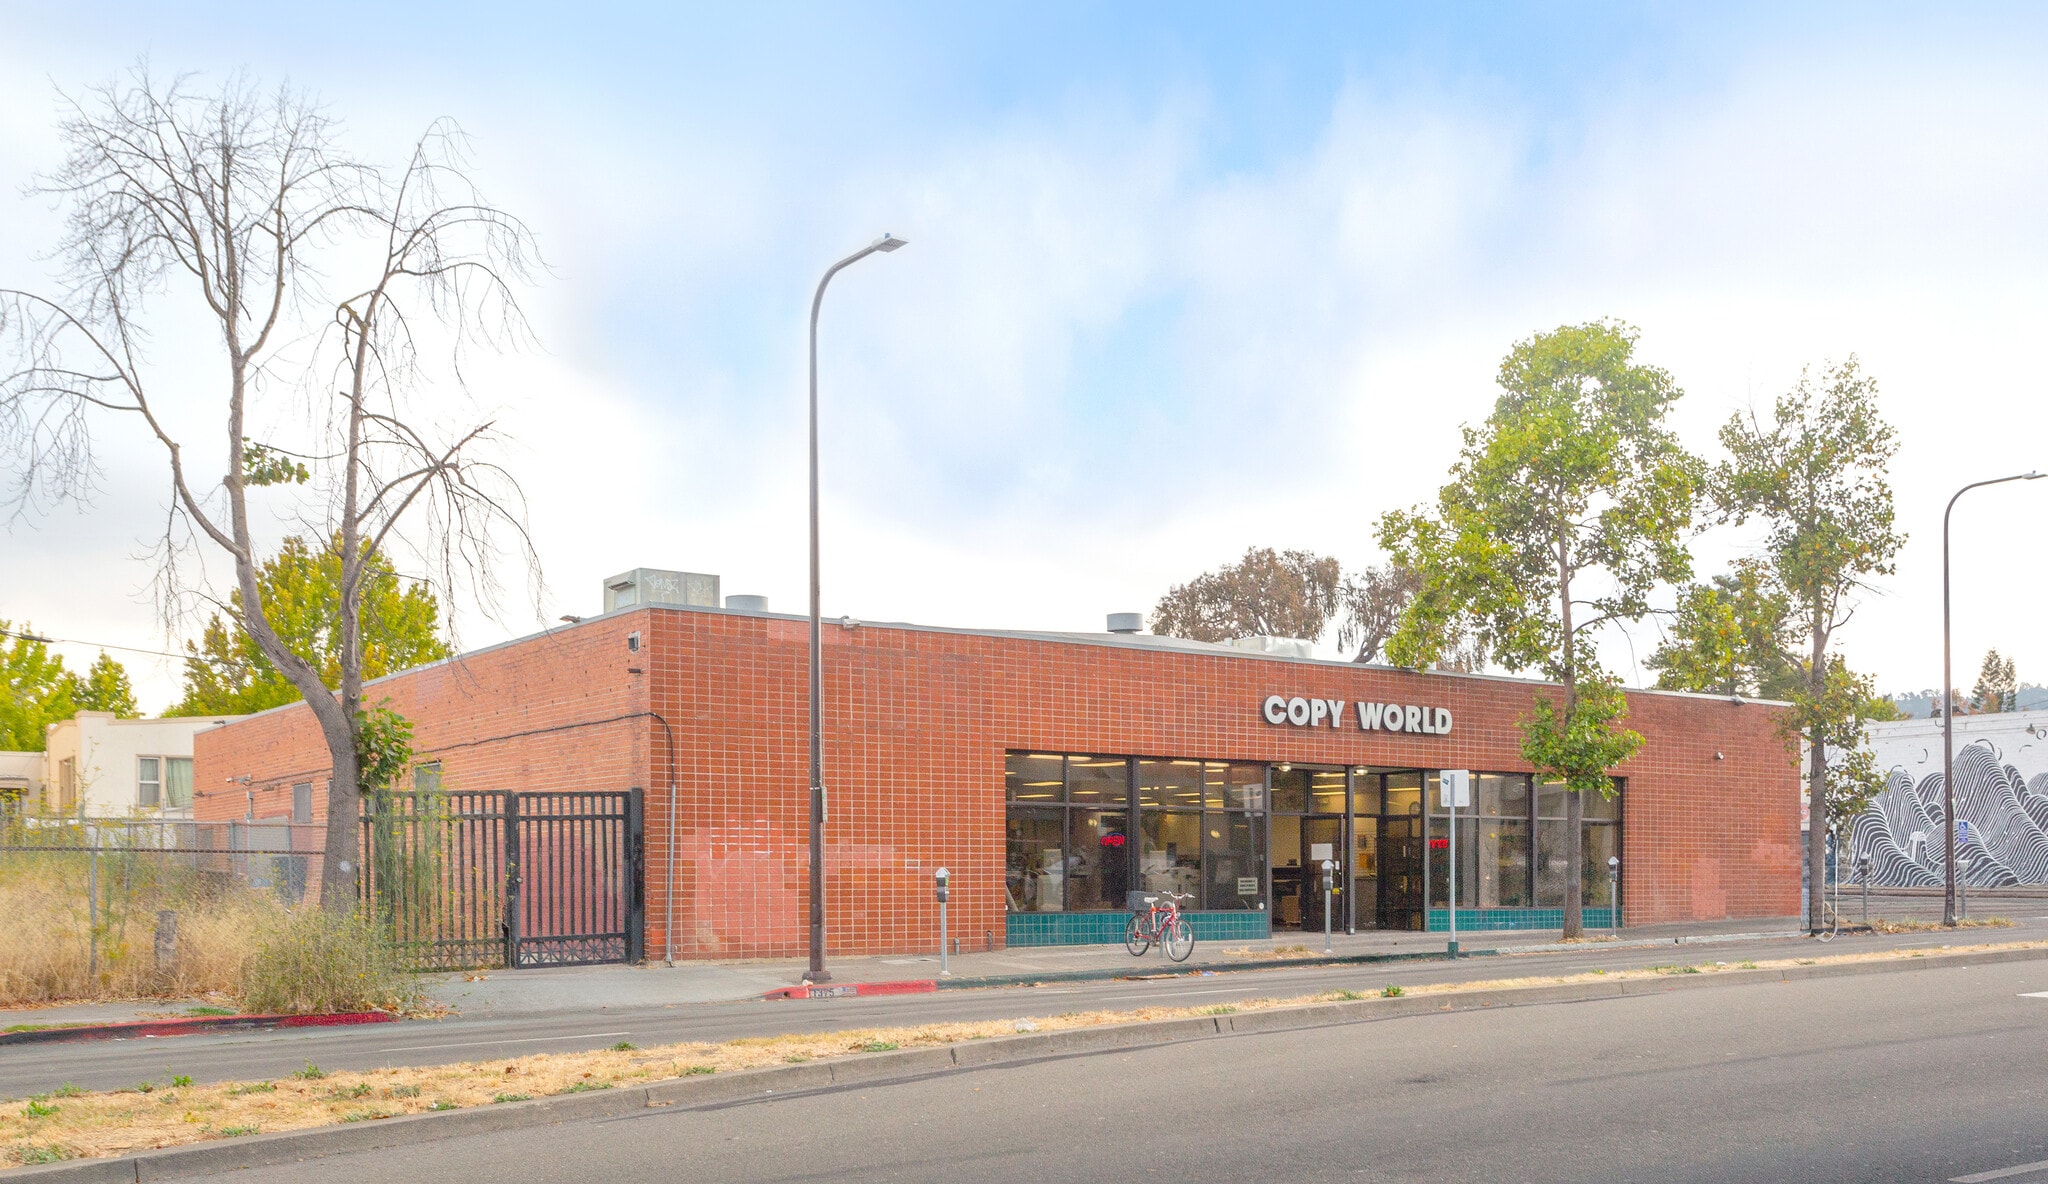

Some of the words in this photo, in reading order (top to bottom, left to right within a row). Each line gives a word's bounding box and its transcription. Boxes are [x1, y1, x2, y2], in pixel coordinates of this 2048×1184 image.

[1263, 695, 1345, 728] COPY
[1356, 701, 1453, 735] WORLD
[1100, 835, 1125, 847] OPEN
